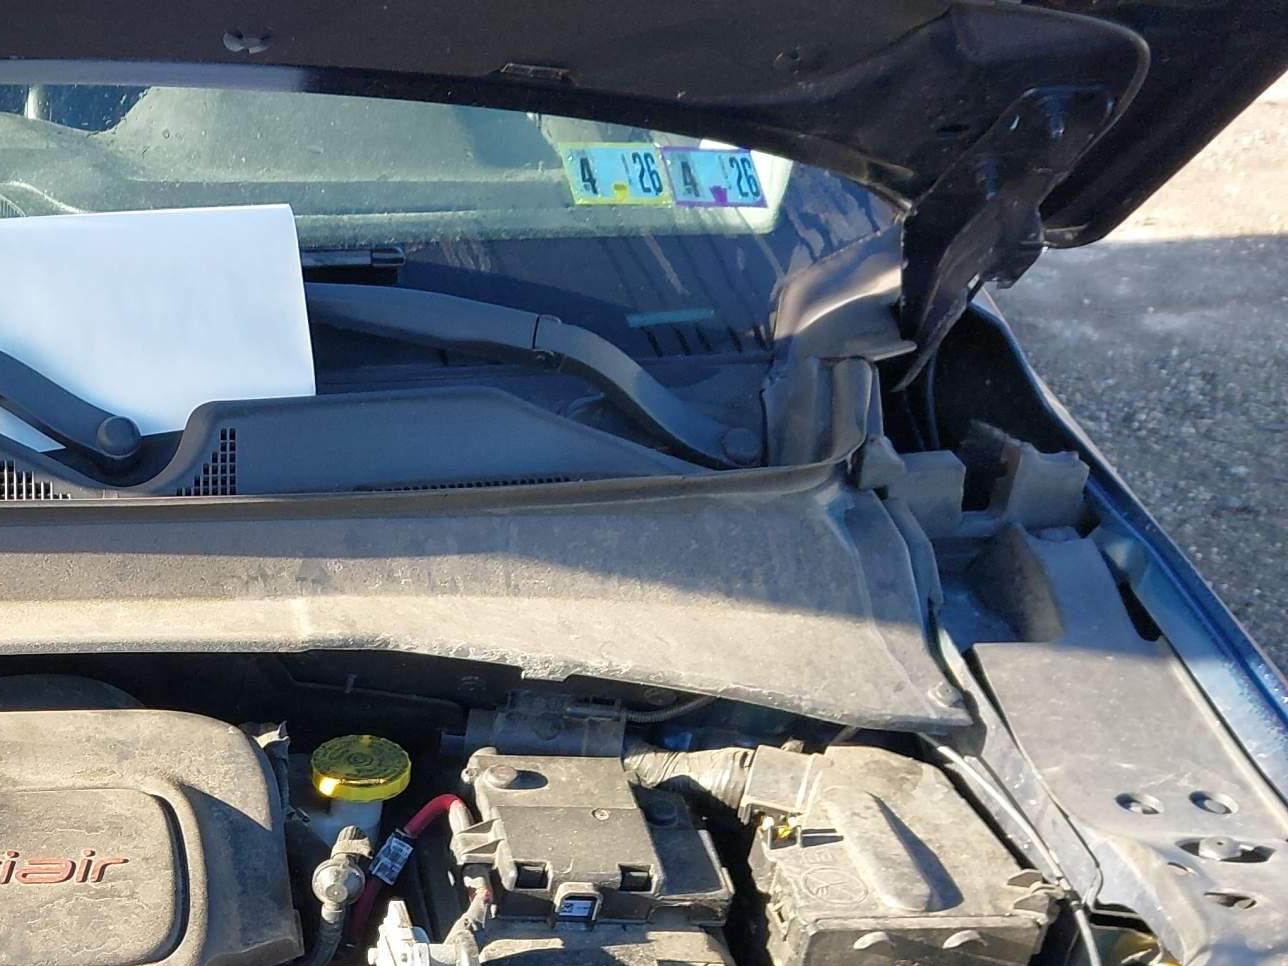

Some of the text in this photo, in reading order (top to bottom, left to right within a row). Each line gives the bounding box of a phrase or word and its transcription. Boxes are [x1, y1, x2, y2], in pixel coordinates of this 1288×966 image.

[579, 151, 663, 196] 4 26
[680, 156, 760, 198] 4 26
